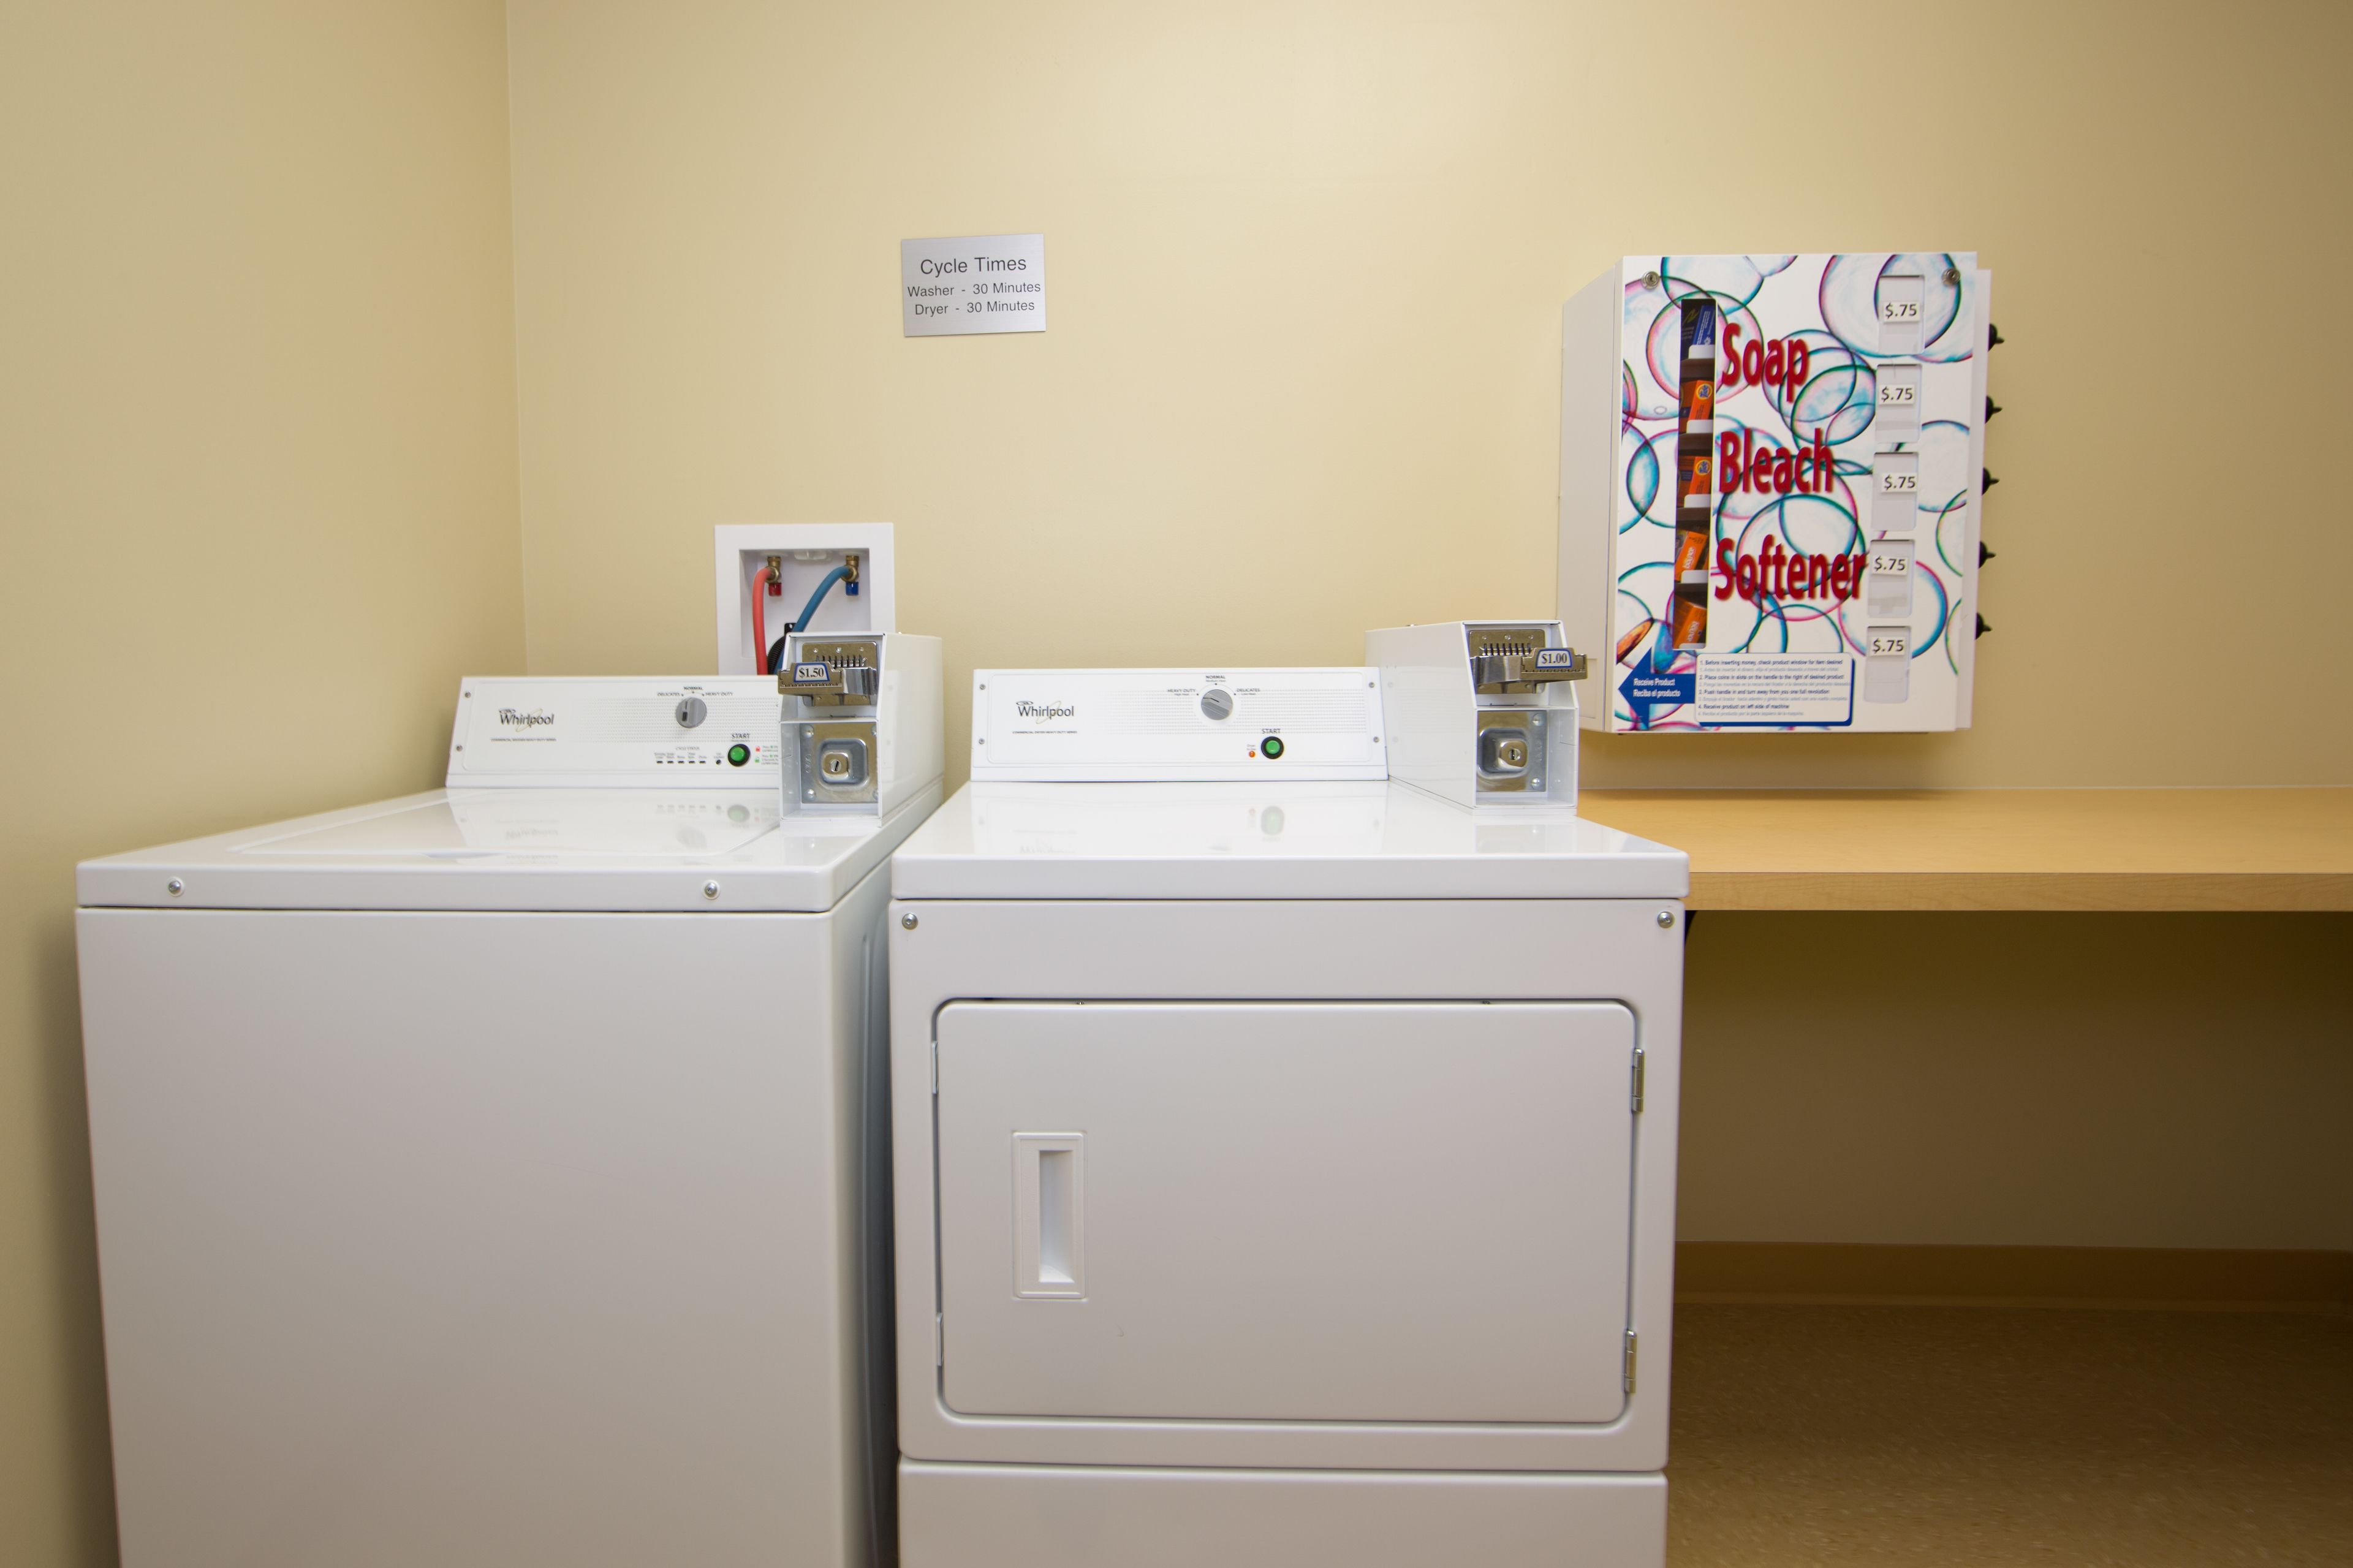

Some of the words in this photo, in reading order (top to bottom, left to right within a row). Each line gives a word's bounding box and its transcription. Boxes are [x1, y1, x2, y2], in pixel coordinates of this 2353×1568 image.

[920, 259, 968, 278] Cycle
[974, 257, 1026, 272] Times
[907, 286, 955, 297] Washer
[972, 284, 988, 295] 30
[993, 282, 1041, 294] Minutes
[915, 304, 949, 317] Dryer
[966, 302, 982, 313] 30
[987, 301, 1035, 312] Minutes
[1885, 303, 1917, 319] $.75
[1721, 322, 1808, 403] Soap
[1881, 387, 1913, 403] $.75
[1718, 428, 1833, 494] Bleach
[1884, 475, 1916, 490] $.75
[1715, 534, 1866, 600] Softener
[1873, 558, 1905, 574] $.75
[1873, 638, 1904, 654] $.75
[1542, 653, 1567, 664] $1.00
[798, 667, 824, 678] $1.50
[500, 713, 555, 728] Whirlpool
[1018, 705, 1074, 720] Whirlpool
